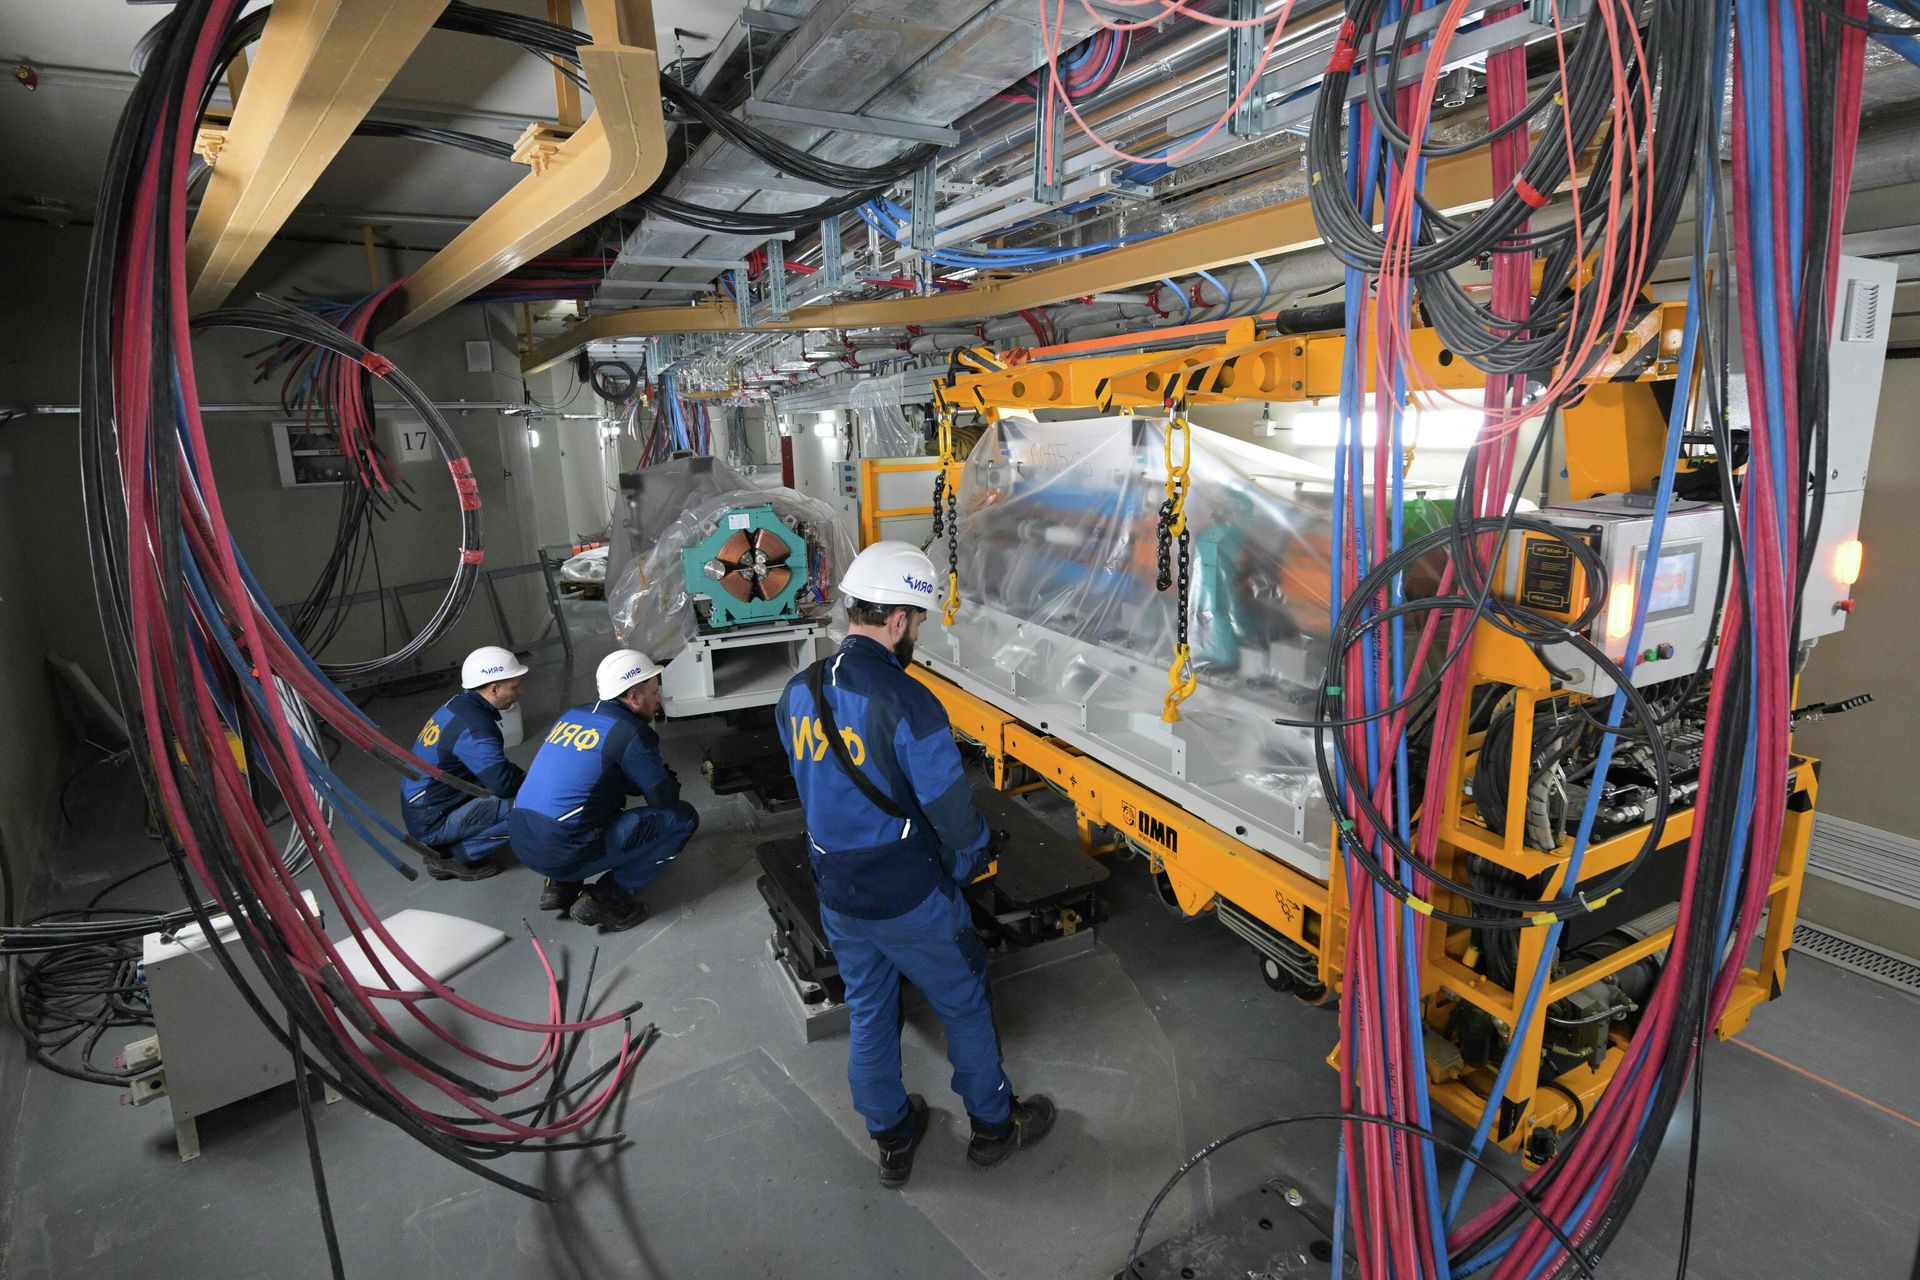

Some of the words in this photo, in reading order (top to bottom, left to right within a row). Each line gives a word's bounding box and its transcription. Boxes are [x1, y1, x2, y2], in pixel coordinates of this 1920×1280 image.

[402, 432, 427, 450] 17
[913, 578, 934, 594] ИЯФ
[488, 665, 505, 675] ИЯФ
[624, 667, 642, 680] ИЯФ
[545, 720, 600, 752] ИЯФ
